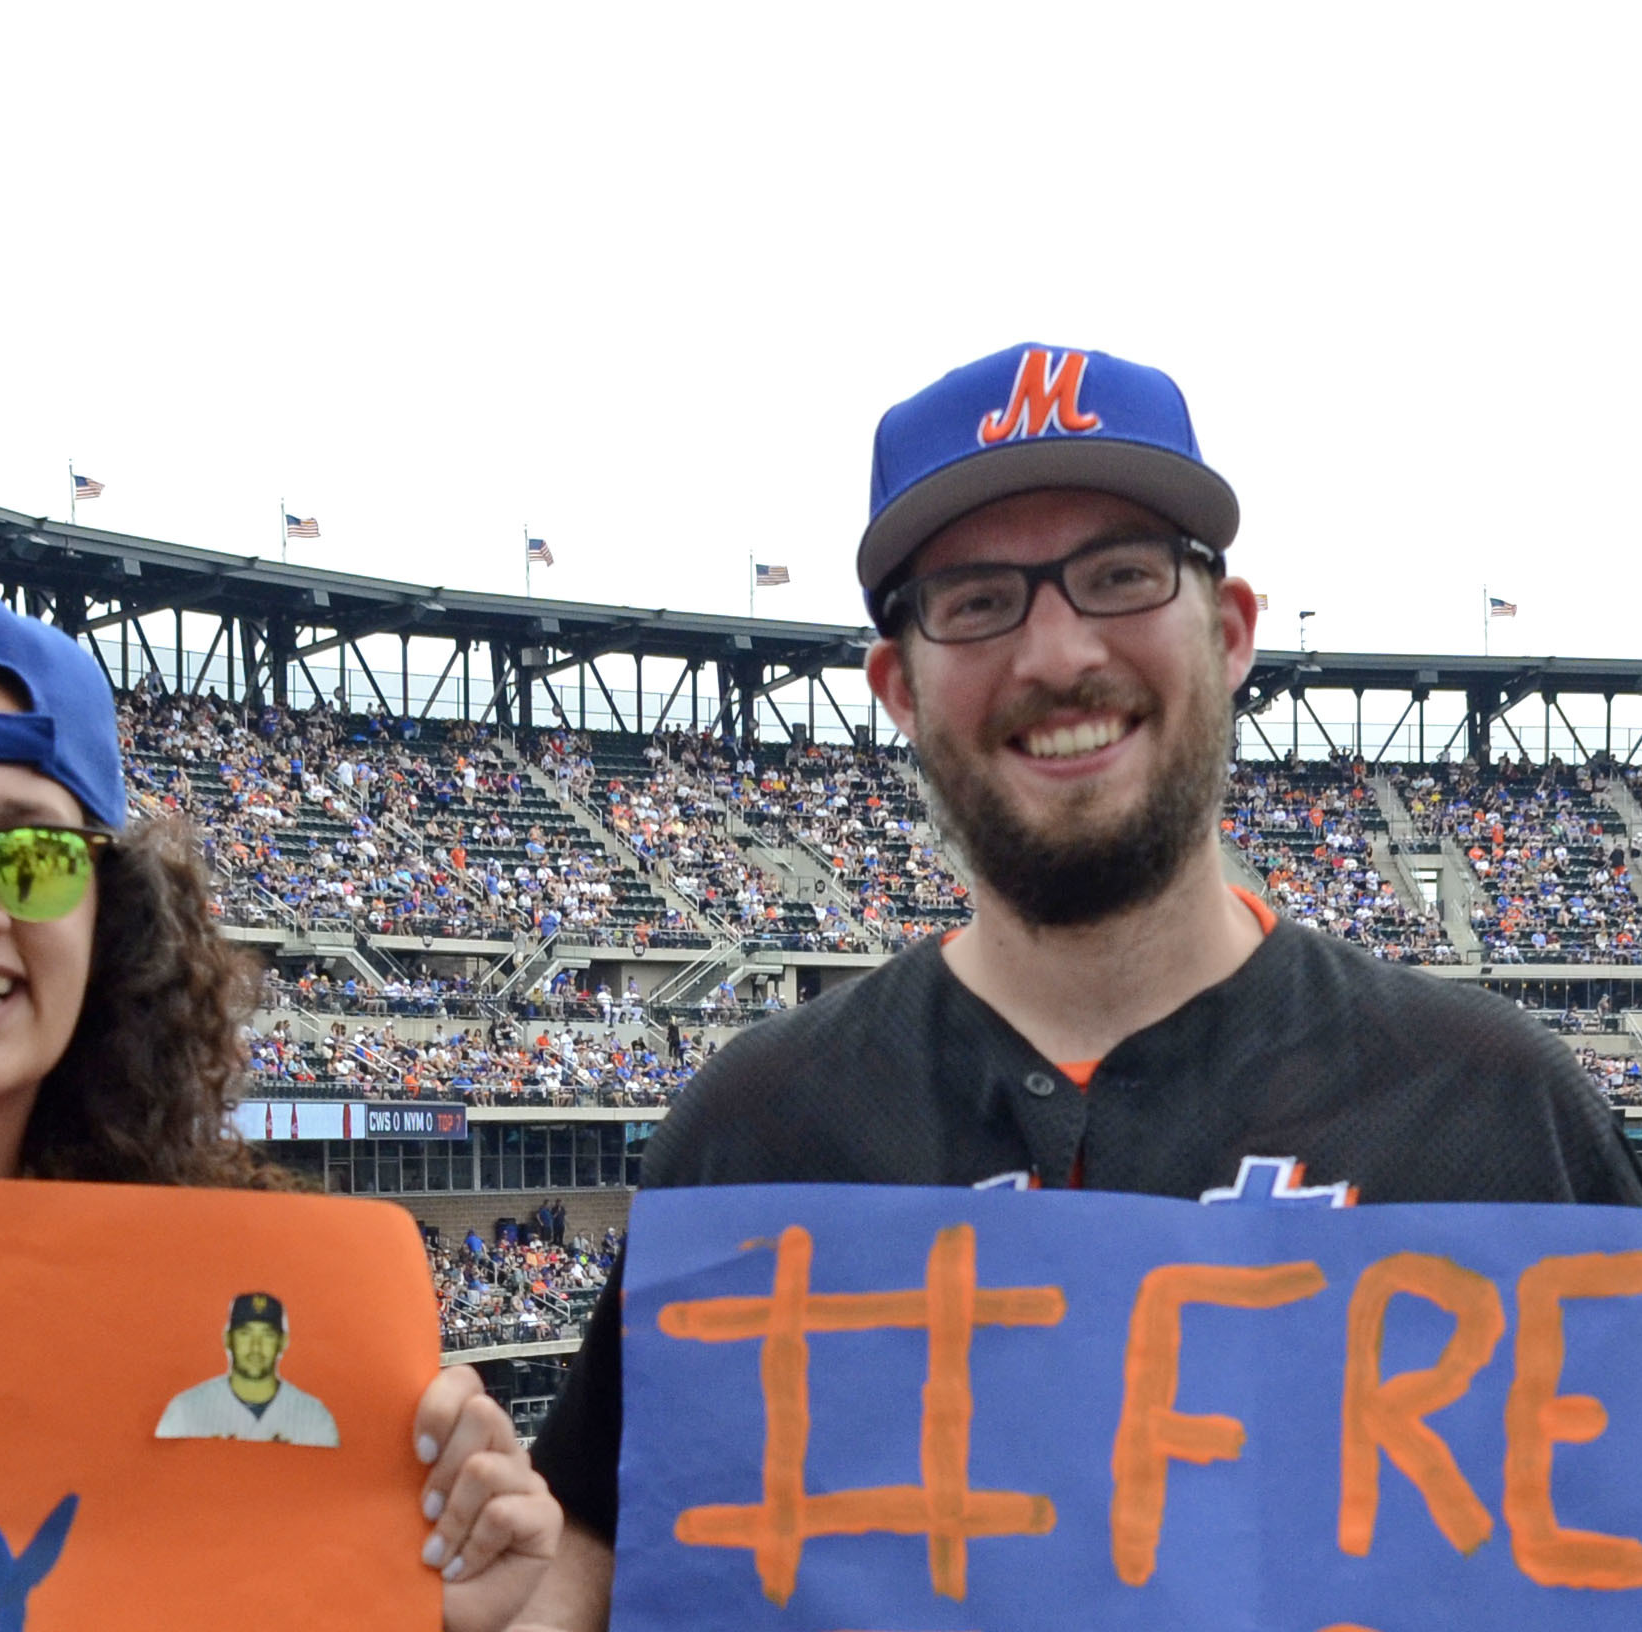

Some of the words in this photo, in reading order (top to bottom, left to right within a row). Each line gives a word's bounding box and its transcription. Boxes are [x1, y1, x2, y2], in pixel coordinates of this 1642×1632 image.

[977, 349, 1103, 447] M
[369, 1112, 391, 1132] CWS
[393, 1112, 400, 1132] 0
[404, 1112, 424, 1132] NYM
[426, 1112, 433, 1132] 0
[438, 1113, 454, 1132] TOP
